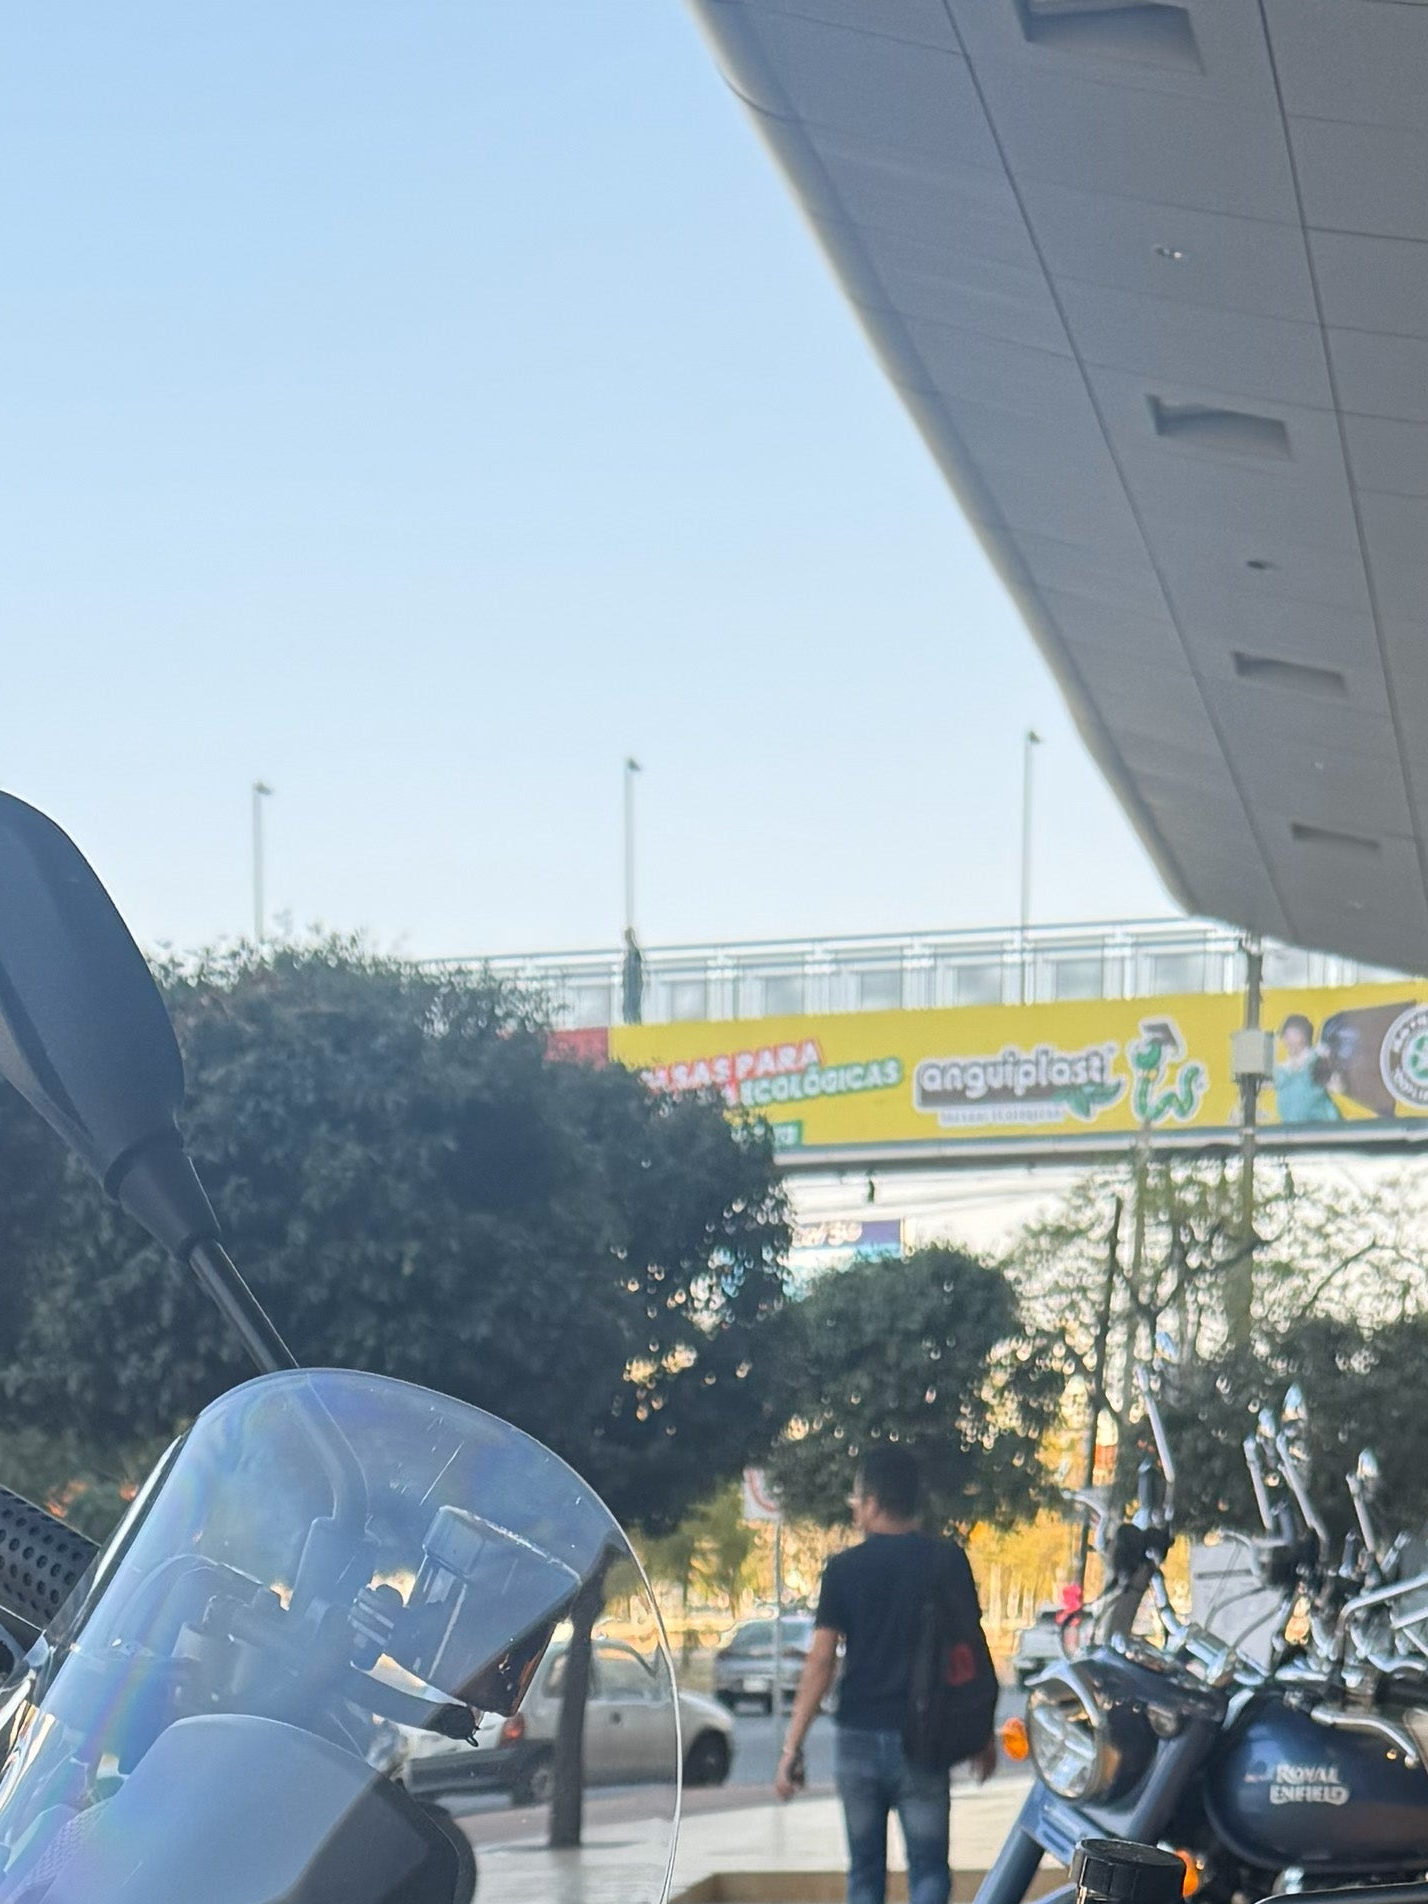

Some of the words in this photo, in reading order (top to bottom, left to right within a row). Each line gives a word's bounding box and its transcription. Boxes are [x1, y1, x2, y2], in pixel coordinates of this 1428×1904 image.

[734, 1039, 822, 1080] PARA
[922, 1049, 1108, 1098] anguiplast
[741, 1057, 901, 1107] ECOLÓGICAS
[1276, 1763, 1342, 1785] ROYAL
[1269, 1784, 1350, 1806] ENFIELD
